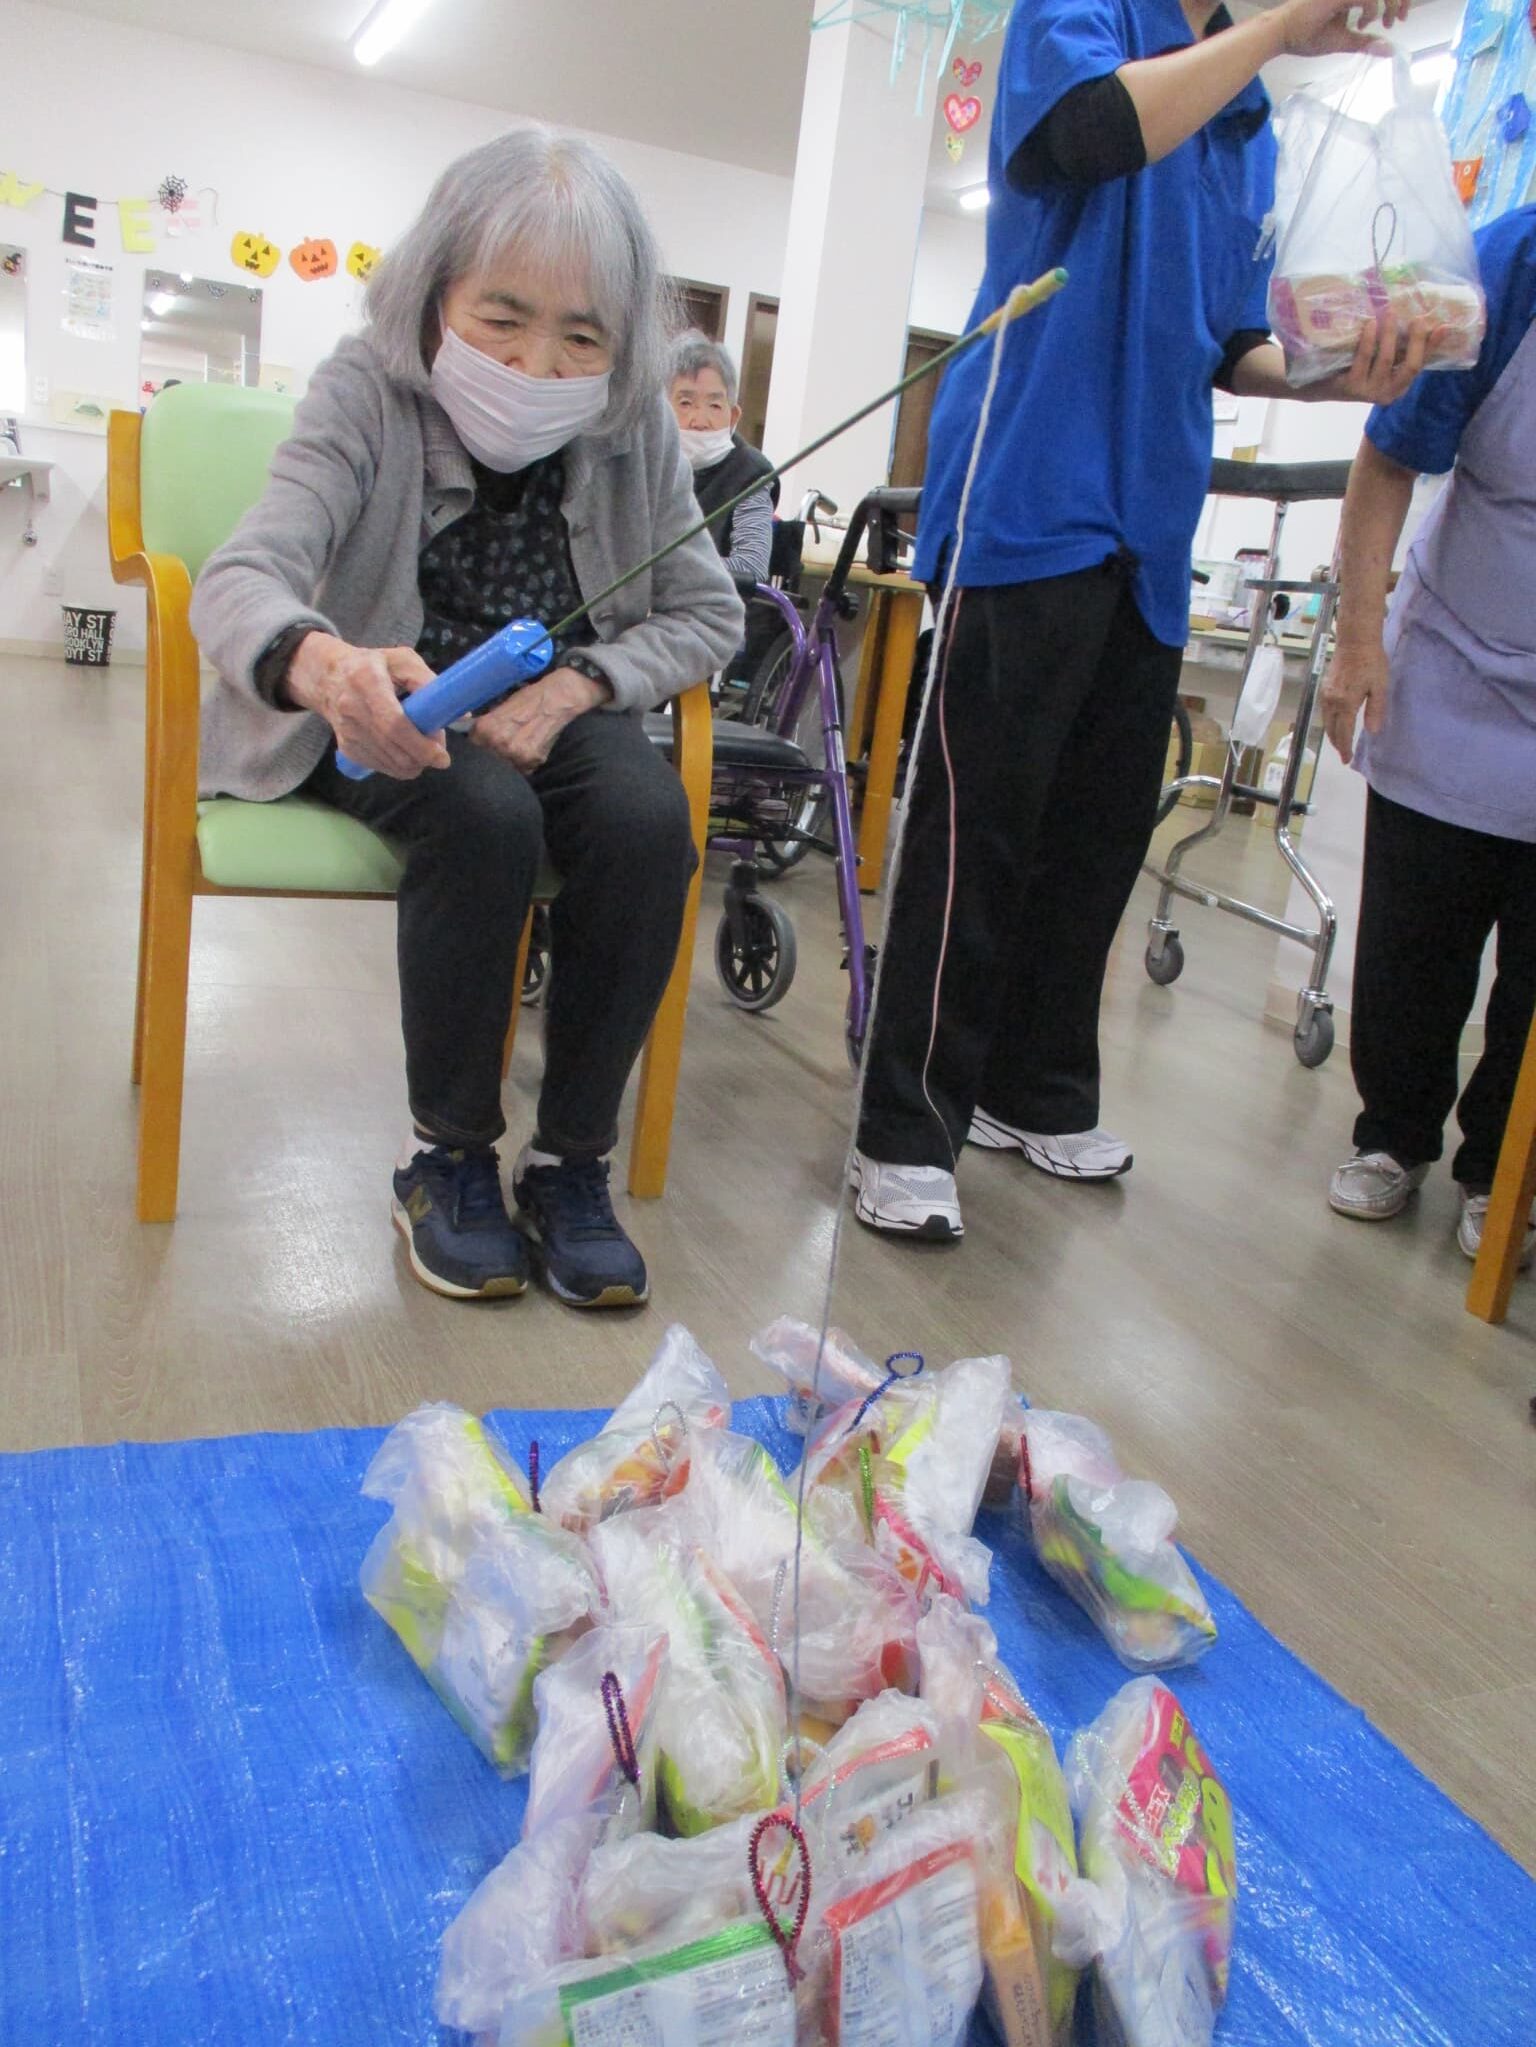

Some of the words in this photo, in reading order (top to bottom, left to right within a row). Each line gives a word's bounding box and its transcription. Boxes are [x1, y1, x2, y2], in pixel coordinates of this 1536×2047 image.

[86, 614, 107, 629] ST
[80, 627, 104, 640] HALL
[88, 649, 103, 662] ST
